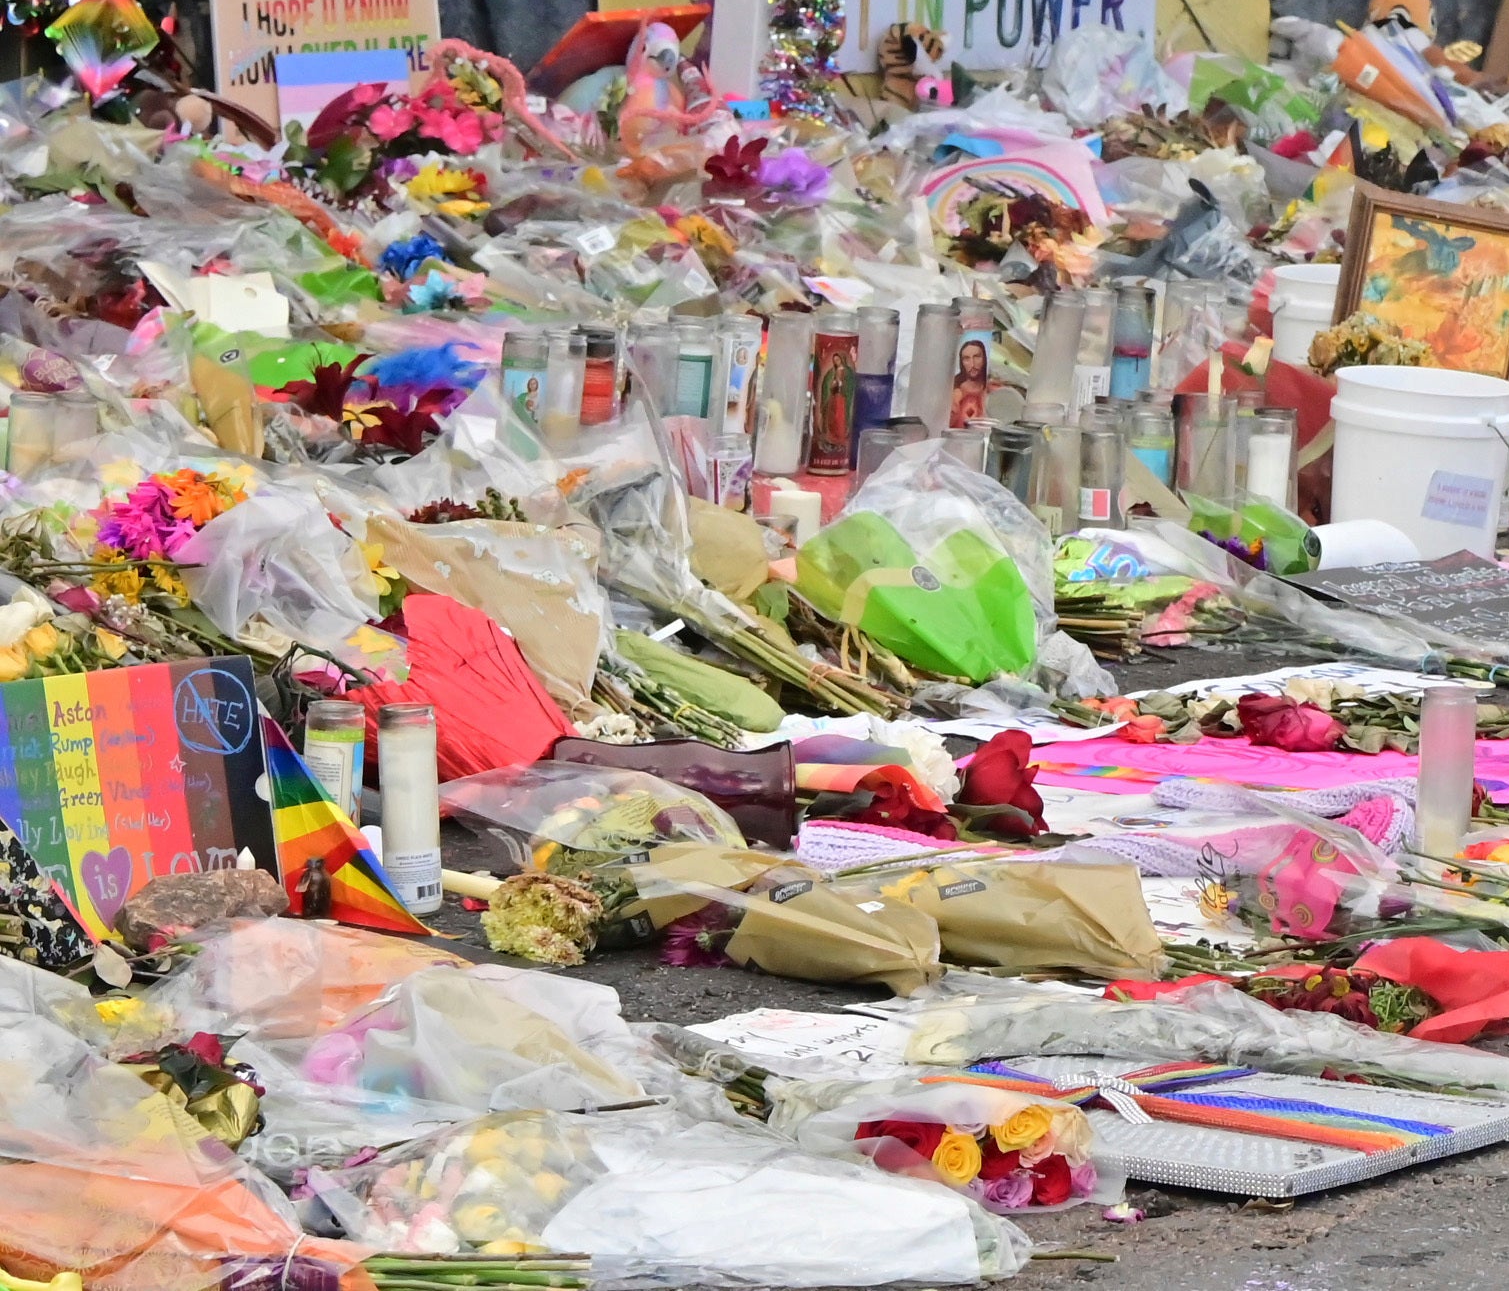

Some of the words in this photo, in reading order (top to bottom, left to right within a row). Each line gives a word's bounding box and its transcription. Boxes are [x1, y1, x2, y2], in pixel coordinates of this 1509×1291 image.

[53, 700, 108, 728] Aston
[182, 695, 244, 730] HATE
[49, 731, 93, 757] Rump
[45, 757, 97, 788] Paugh
[58, 786, 104, 810] Green
[93, 864, 120, 902] is
